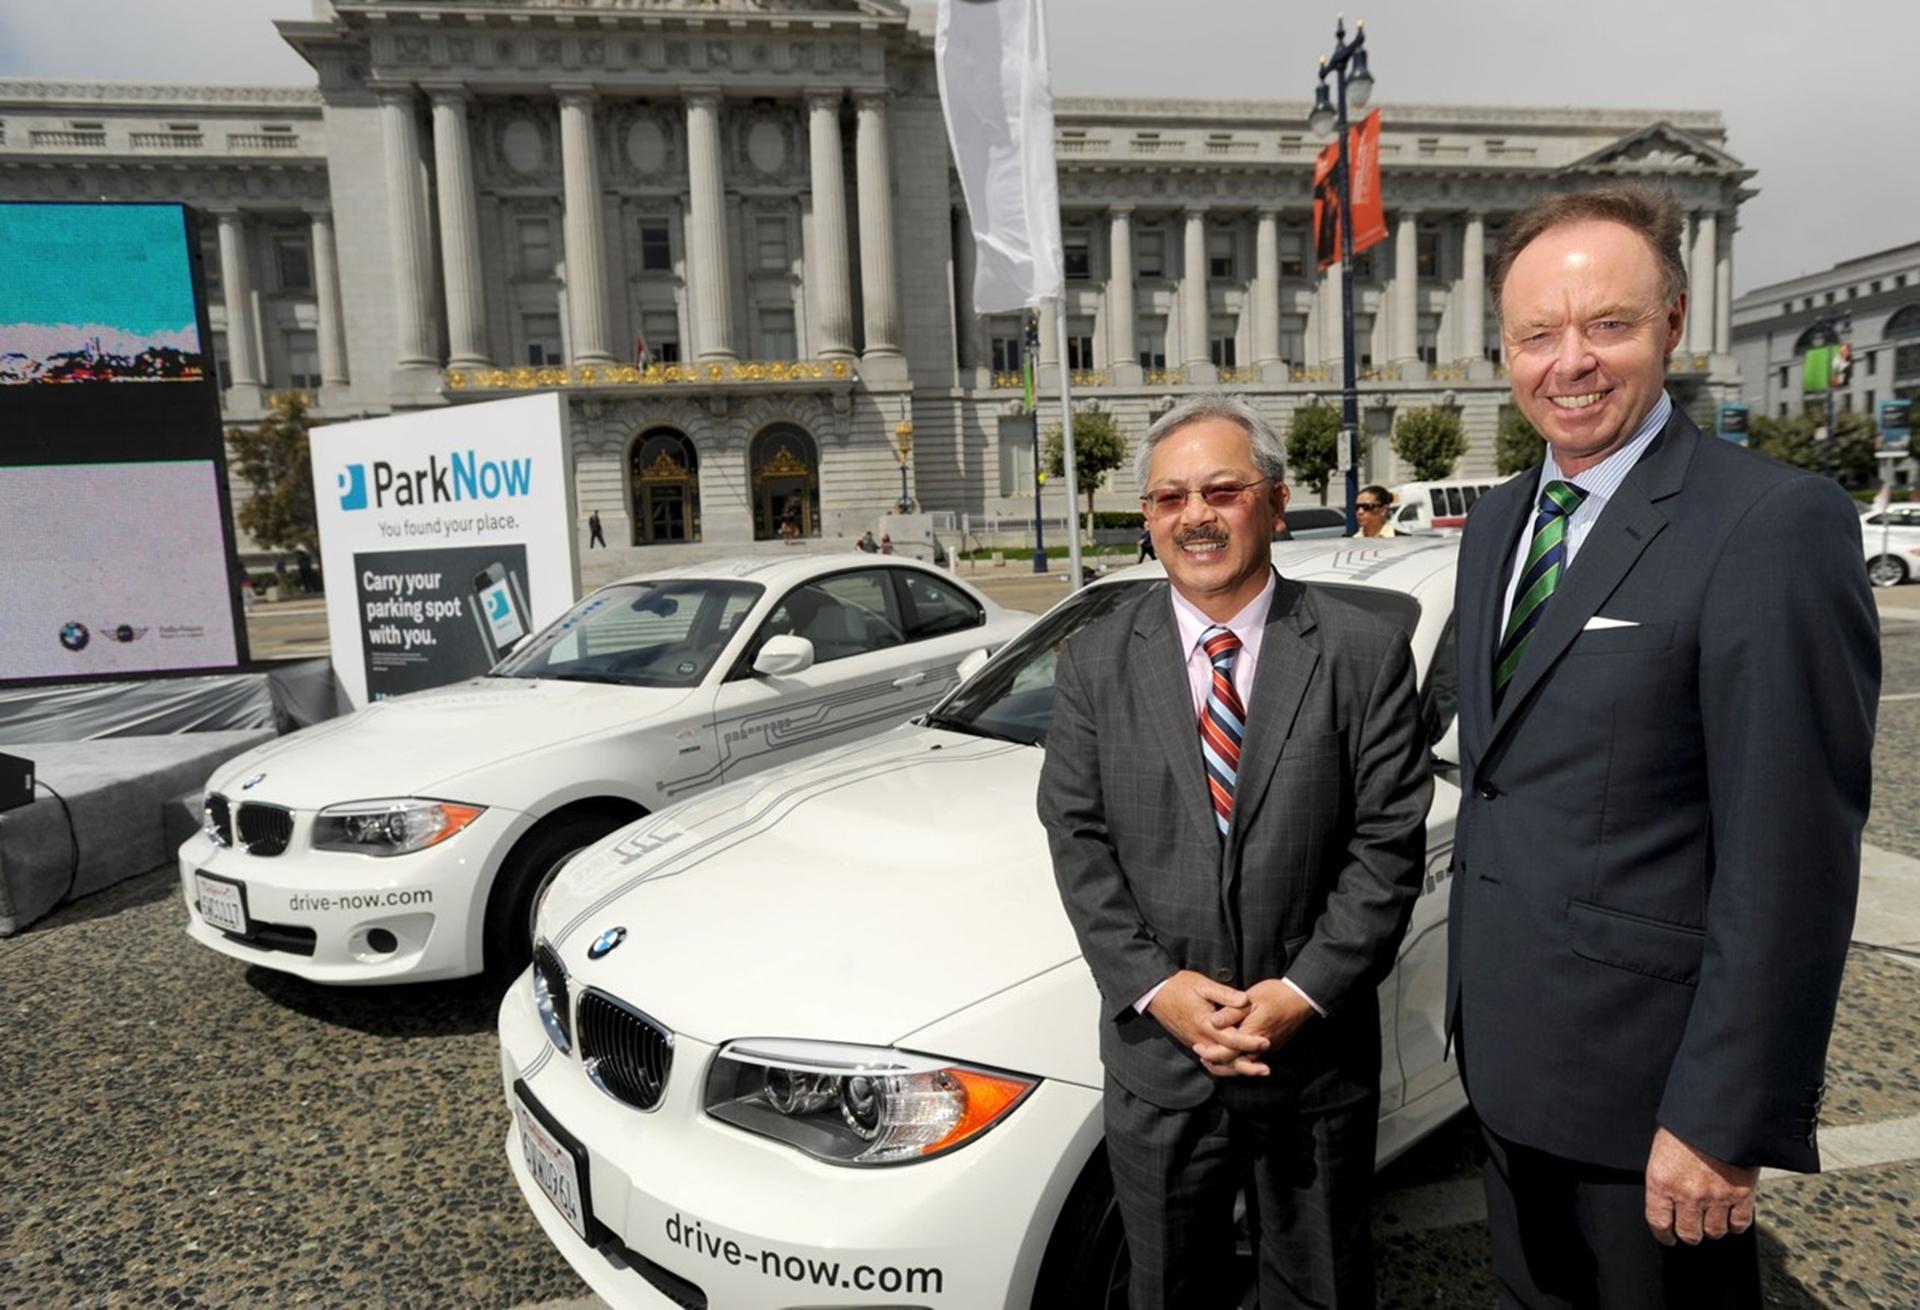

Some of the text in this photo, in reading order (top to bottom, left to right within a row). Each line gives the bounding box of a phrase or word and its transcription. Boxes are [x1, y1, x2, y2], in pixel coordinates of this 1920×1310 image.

[373, 450, 532, 509] ParkNow
[378, 513, 520, 538] You found your place.
[363, 570, 442, 596] Carry your
[366, 596, 462, 623] parking spot
[368, 624, 437, 650] with you.
[289, 888, 434, 912] drive-now.com
[664, 1212, 945, 1294] drive-now.com
